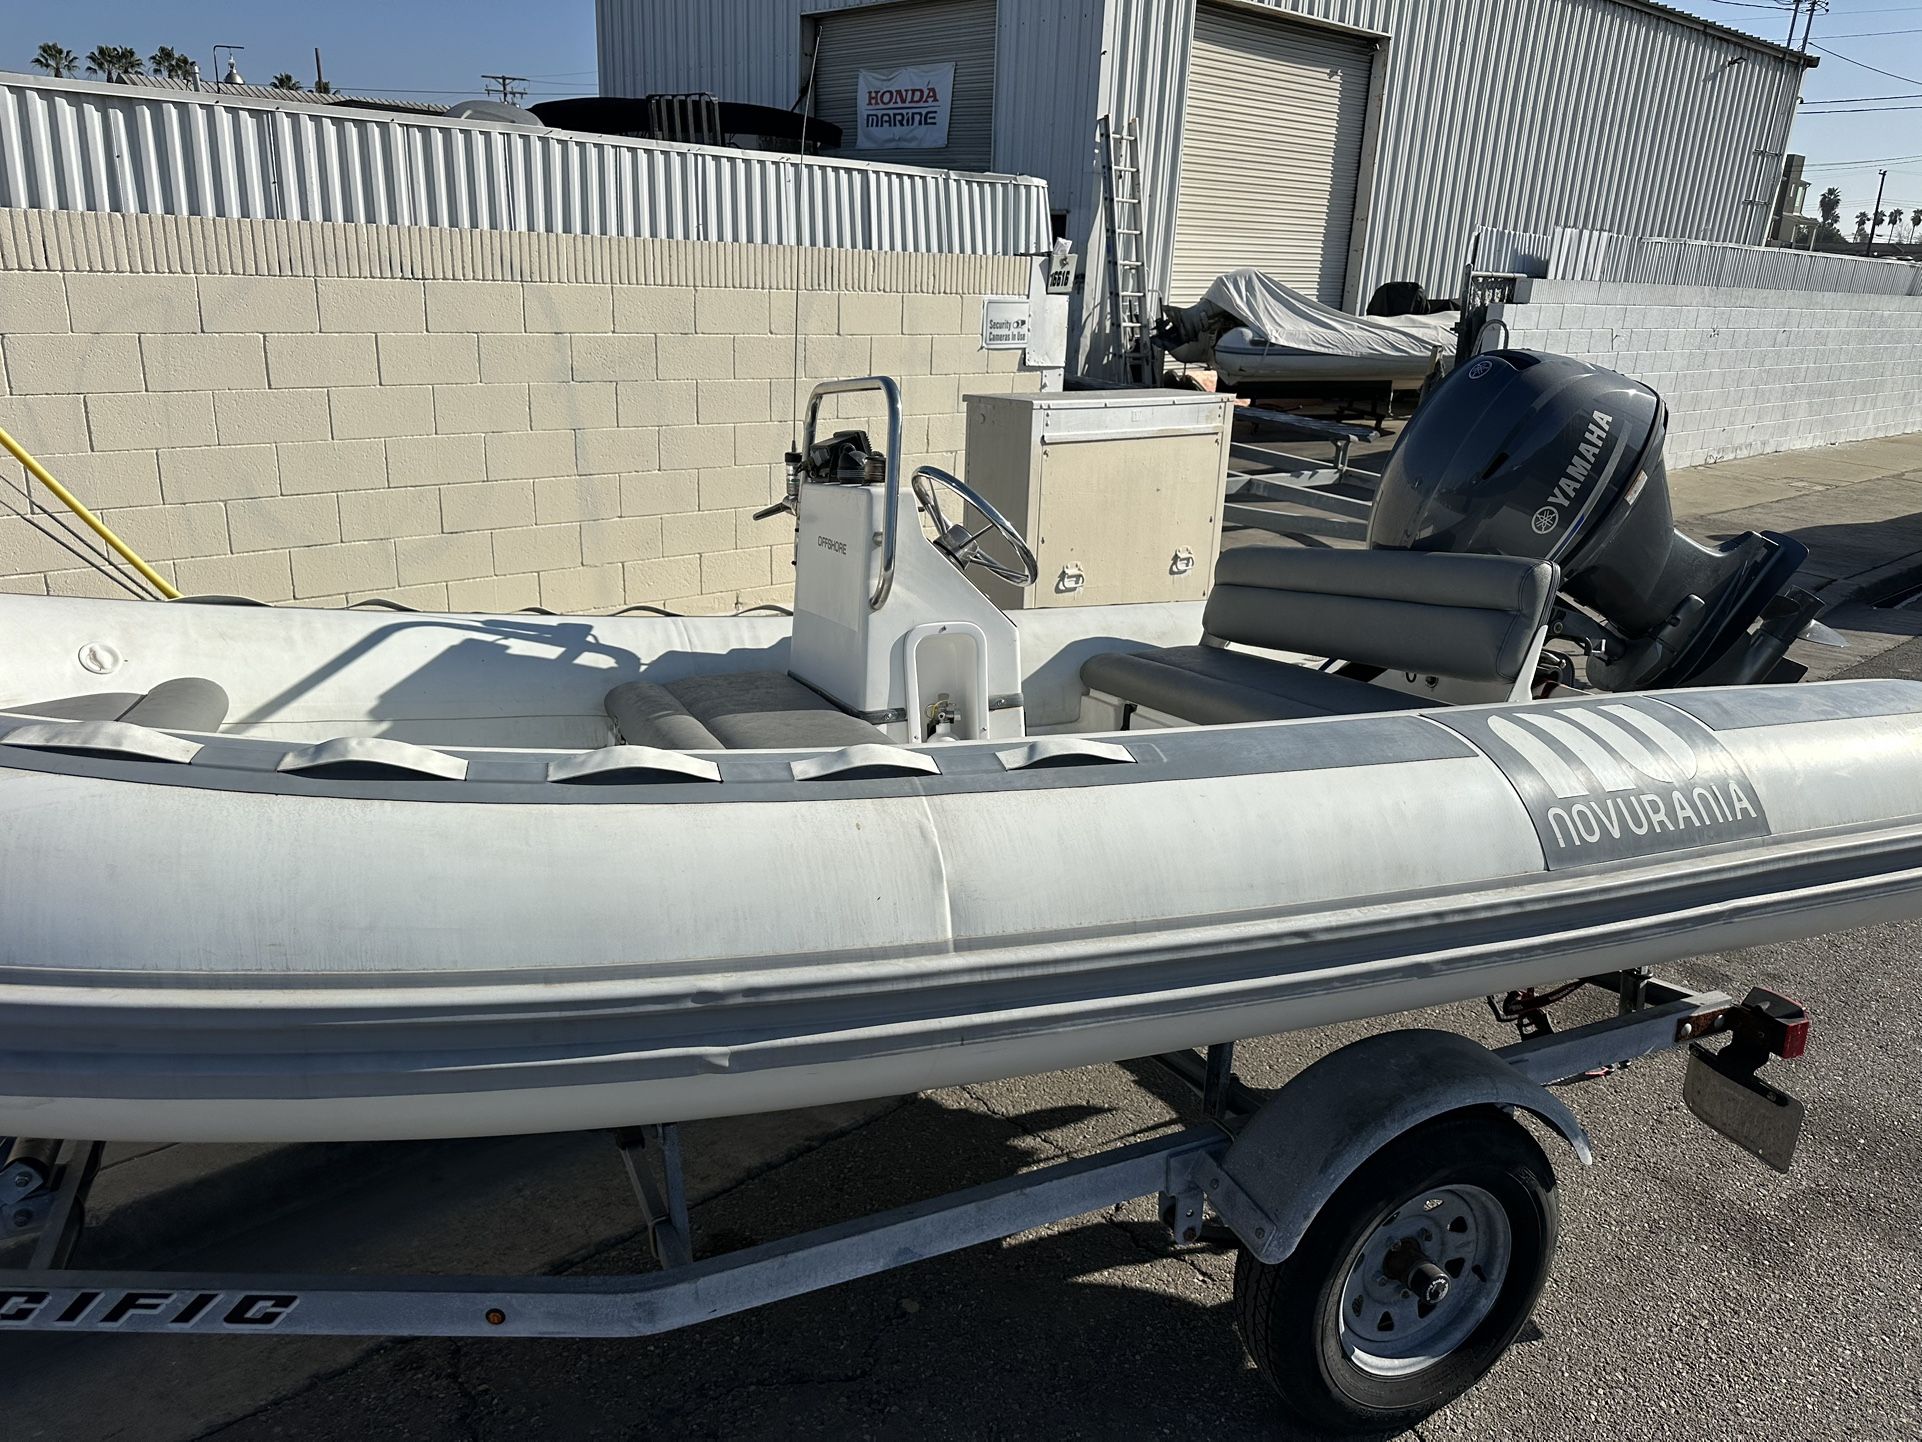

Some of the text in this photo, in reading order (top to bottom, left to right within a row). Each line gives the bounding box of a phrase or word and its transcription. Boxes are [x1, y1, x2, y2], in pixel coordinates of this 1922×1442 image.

[866, 87, 939, 106] HONDA
[866, 111, 938, 128] MARINE
[989, 319, 1011, 331] Security
[988, 331, 1011, 341] Cameras
[1017, 331, 1026, 341] Use
[1547, 410, 1613, 508] YAMAHA
[817, 535, 847, 555] OFFSHORE
[1547, 780, 1757, 848] NOVURANIA
